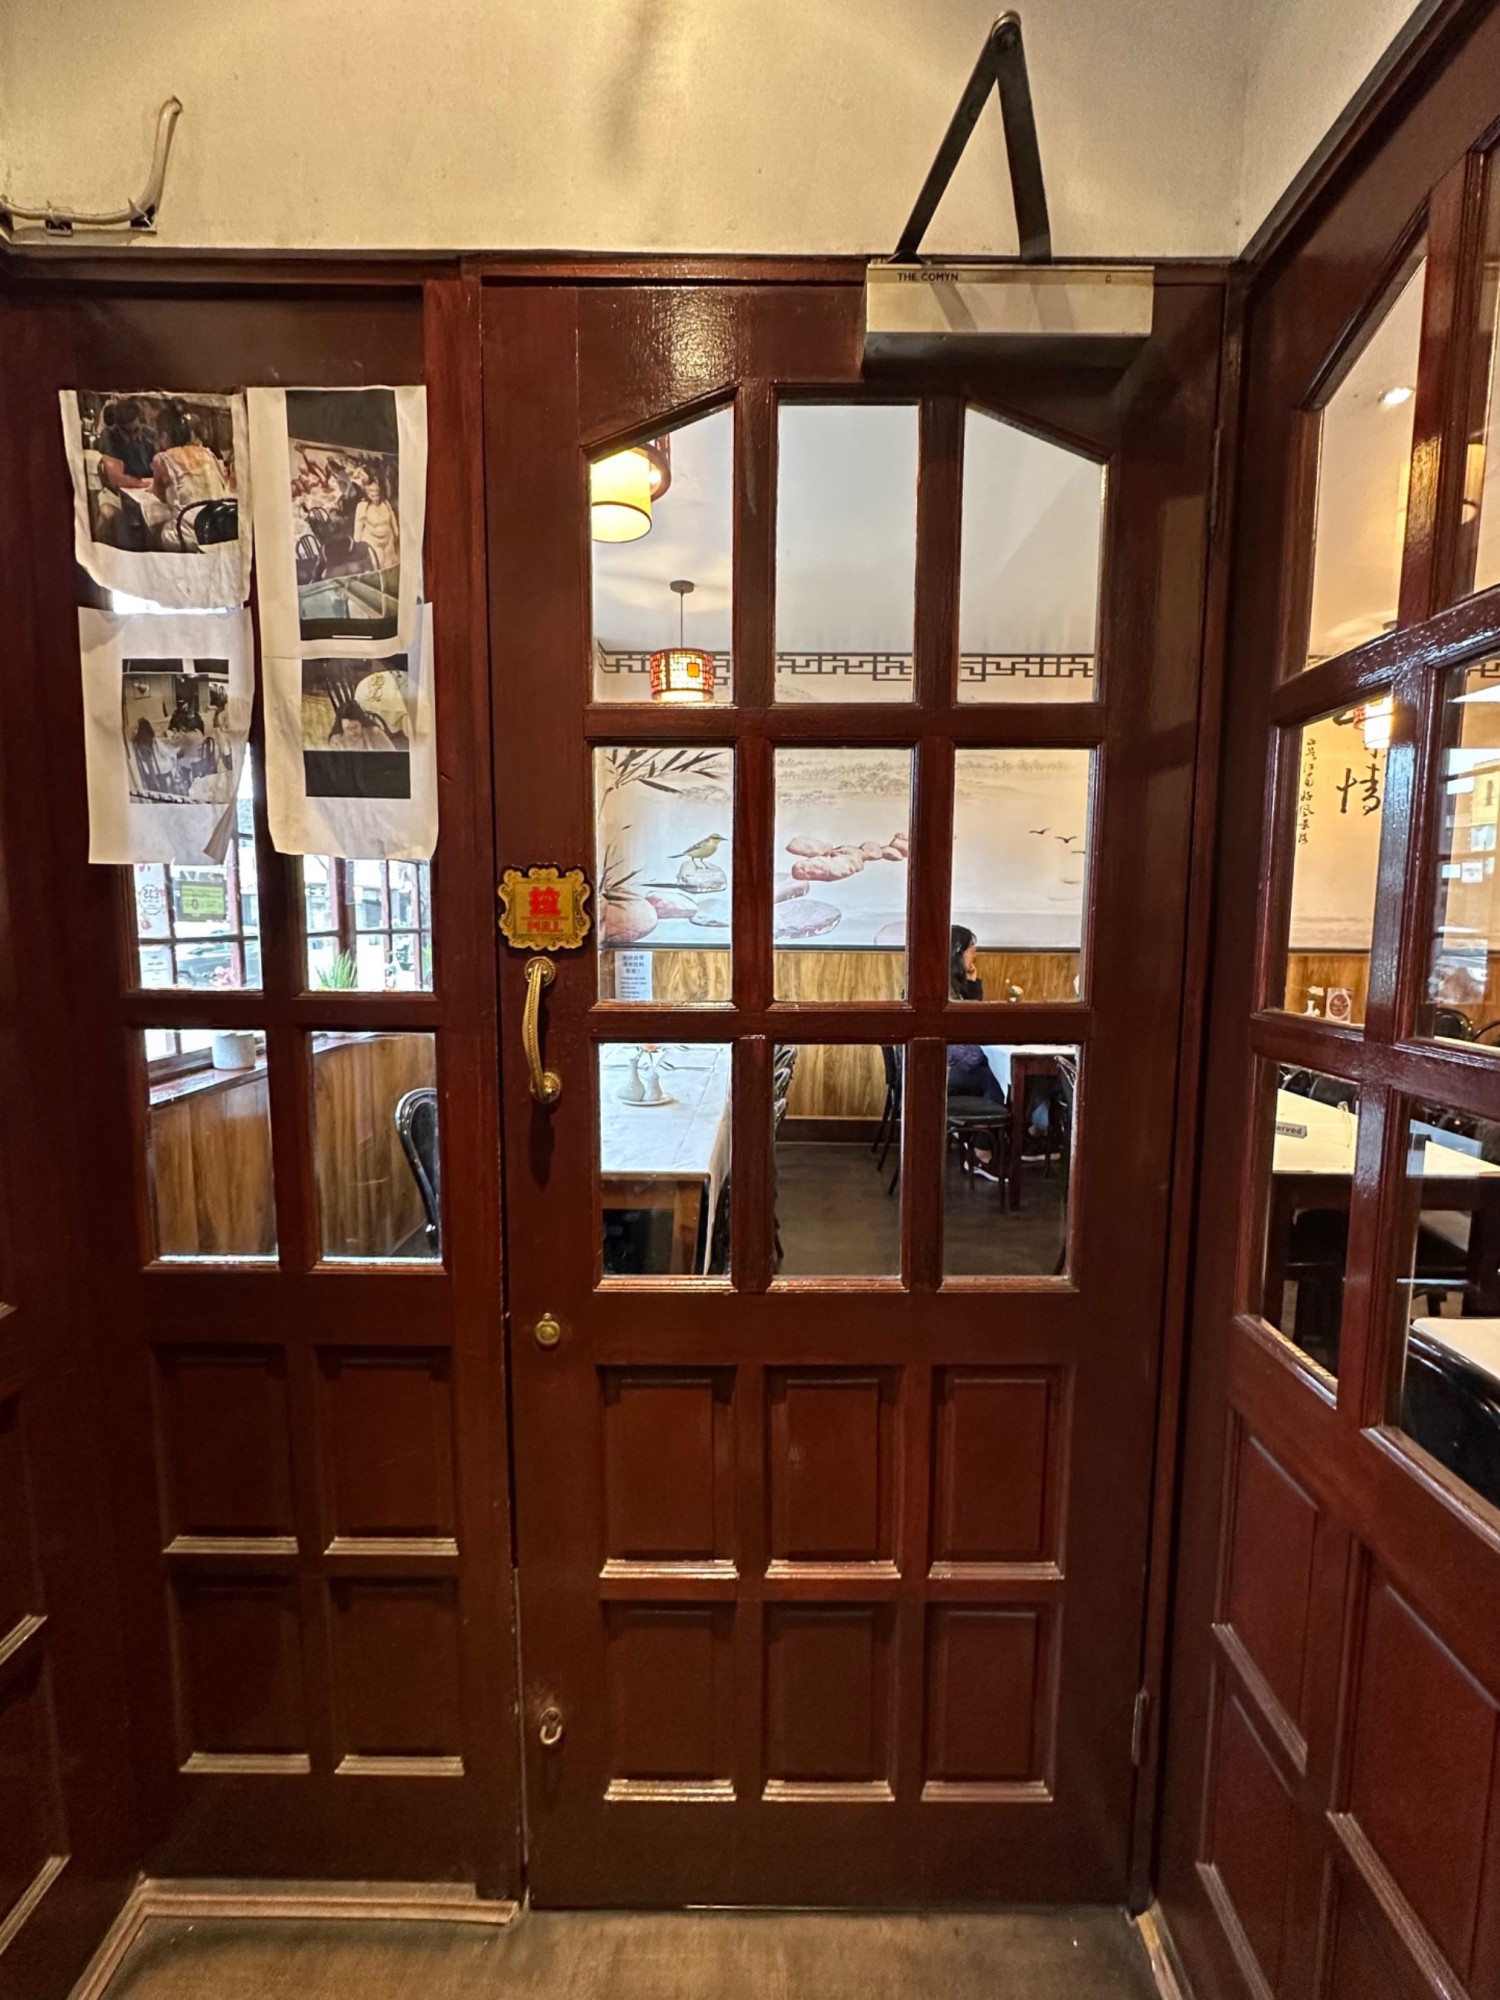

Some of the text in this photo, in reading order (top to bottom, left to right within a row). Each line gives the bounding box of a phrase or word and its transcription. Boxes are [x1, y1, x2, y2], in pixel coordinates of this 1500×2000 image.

[897, 272, 959, 281] THE COMYN
[1276, 1125, 1302, 1135] erved
